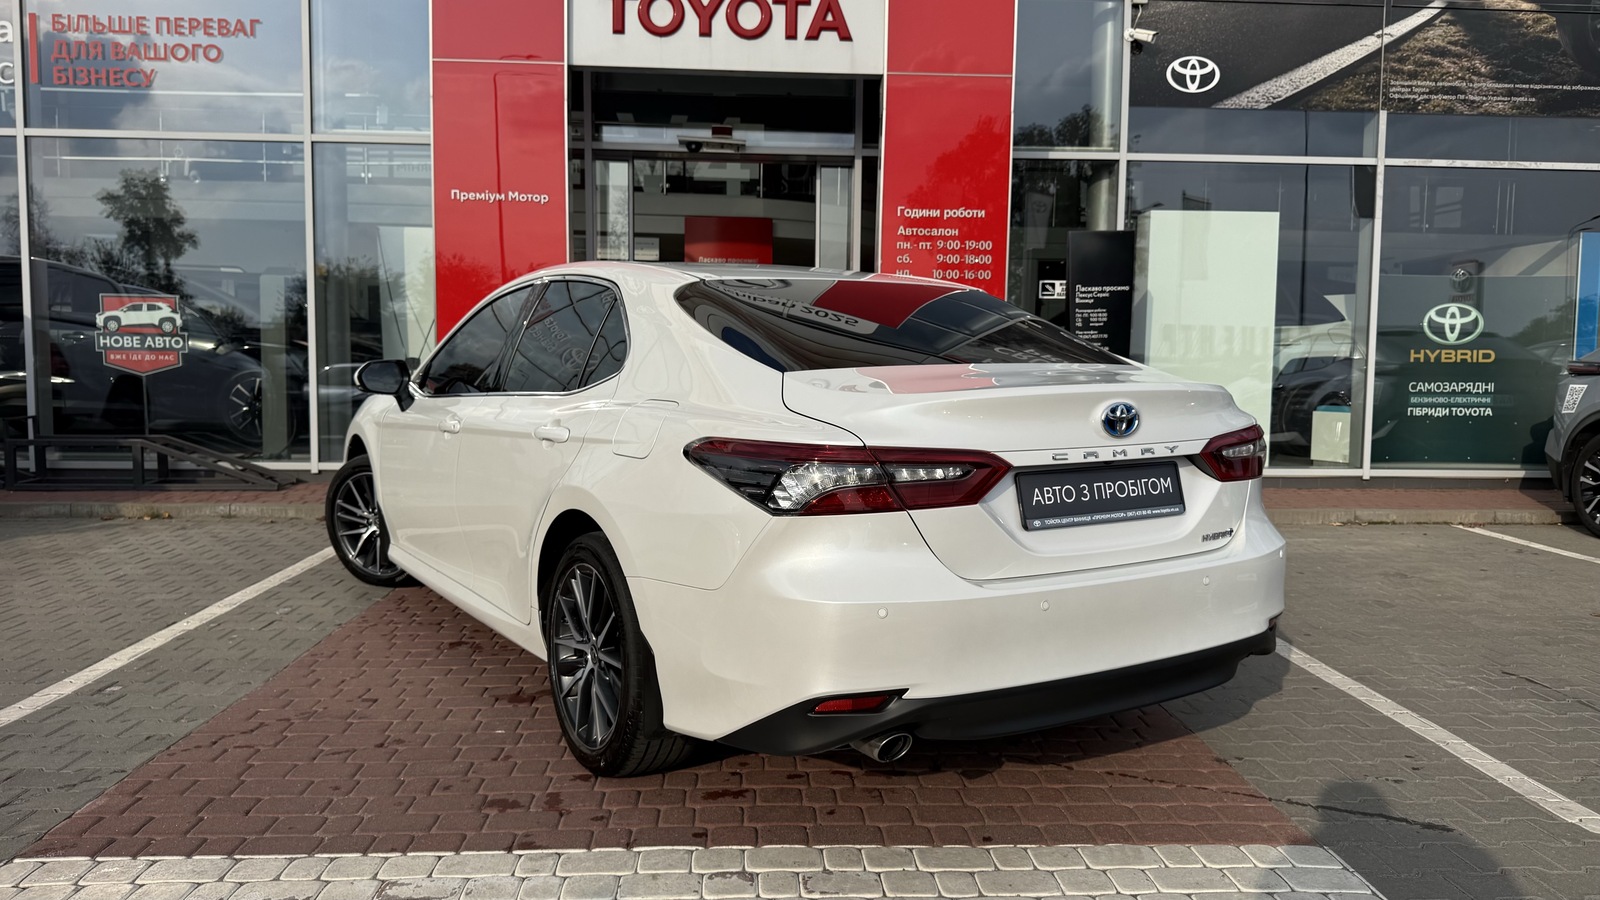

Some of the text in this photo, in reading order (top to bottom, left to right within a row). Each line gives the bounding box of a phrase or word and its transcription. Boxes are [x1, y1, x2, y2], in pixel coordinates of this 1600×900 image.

[51, 14, 262, 38] БІЛЬШЕ ПЕРЕВАГ
[610, 0, 853, 41] TOYOTA
[51, 40, 223, 63] ДЛЯ ВАШОГО
[52, 67, 157, 88] БІЗНЕСУ
[451, 189, 549, 204] Преміум Мотор
[897, 206, 986, 220] Години роботи
[897, 225, 959, 236] Автосалон
[896, 253, 913, 264] сб.
[100, 335, 184, 349] НОВЕ АВТО
[129, 353, 142, 361] ЇДЕ
[1409, 349, 1496, 363] HYBRID
[1408, 382, 1495, 394] САМОЗАРЯДНІ
[1407, 407, 1493, 418] ГІБРИДИ TOYOTA
[1052, 445, 1179, 461] CAMRY
[1032, 485, 1076, 506] АВТО
[1094, 476, 1173, 500] ПРОБІГОМ
